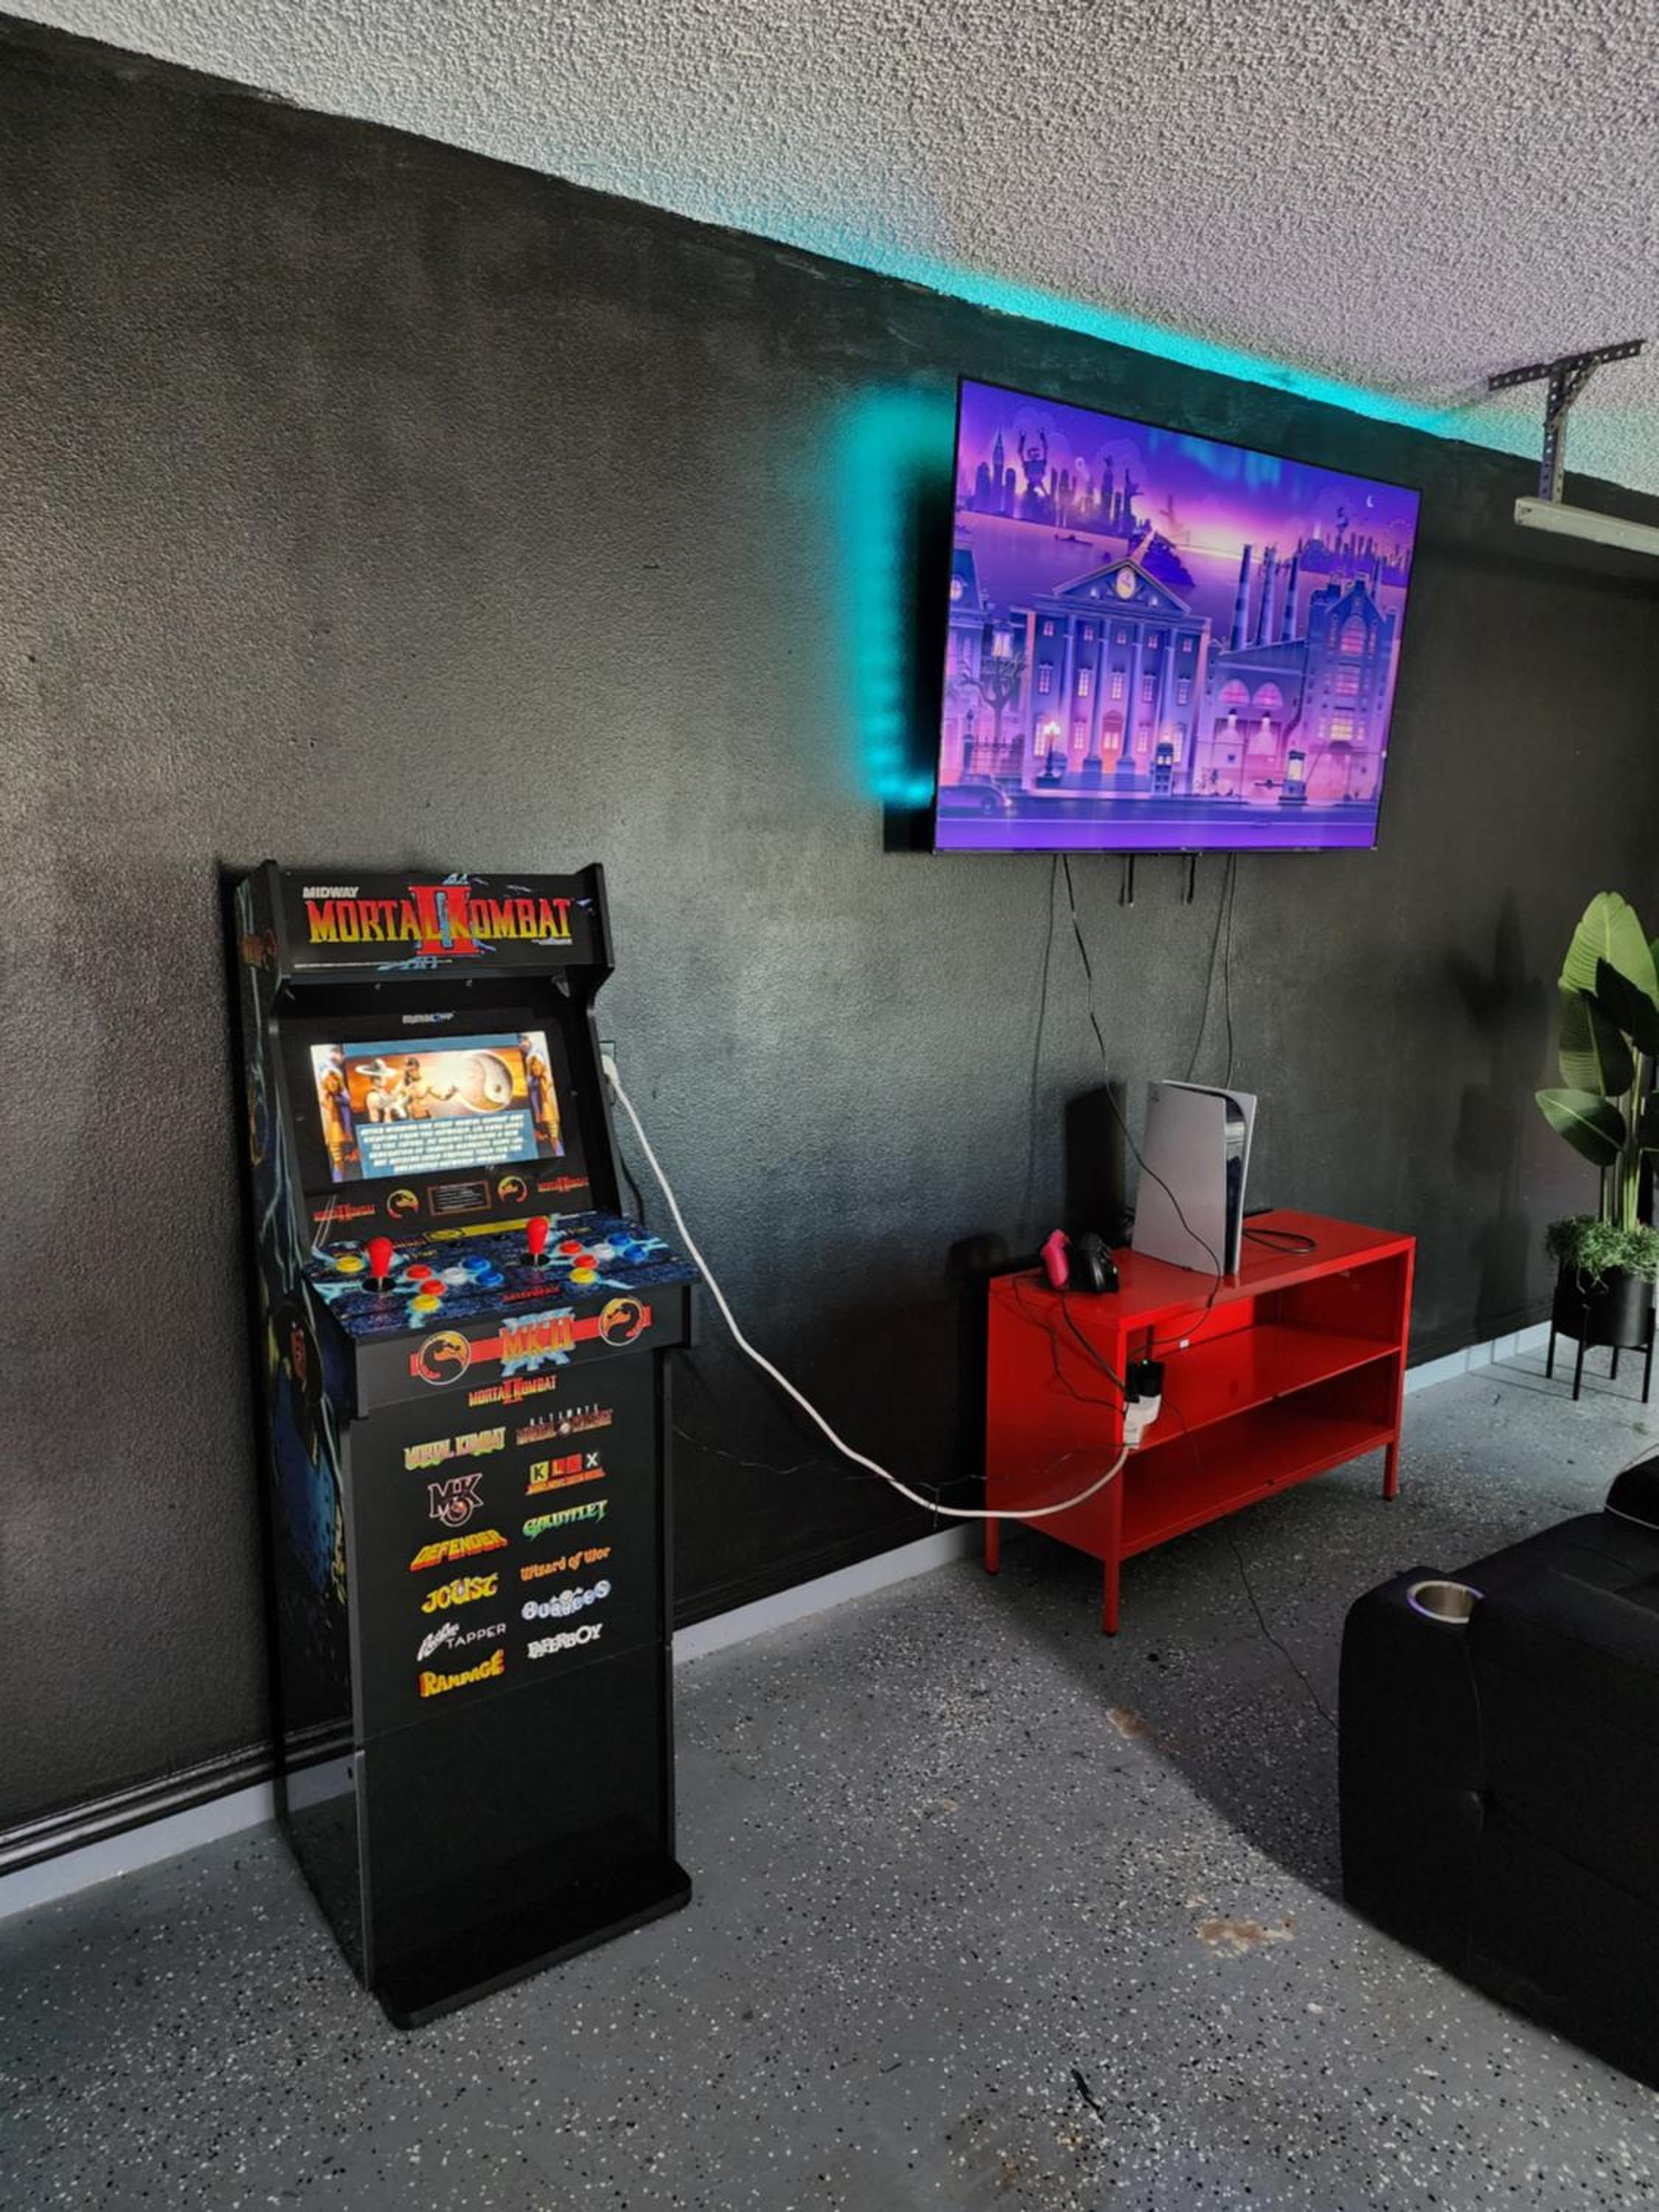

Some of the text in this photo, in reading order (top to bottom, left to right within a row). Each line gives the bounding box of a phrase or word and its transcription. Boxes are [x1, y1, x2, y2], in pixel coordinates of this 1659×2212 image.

[303, 886, 359, 899] MIDWAY
[305, 899, 442, 944] MORTAL
[445, 897, 572, 940] KOMBAT
[421, 1571, 498, 1614] JOUST
[445, 1622, 507, 1649] TAPPER
